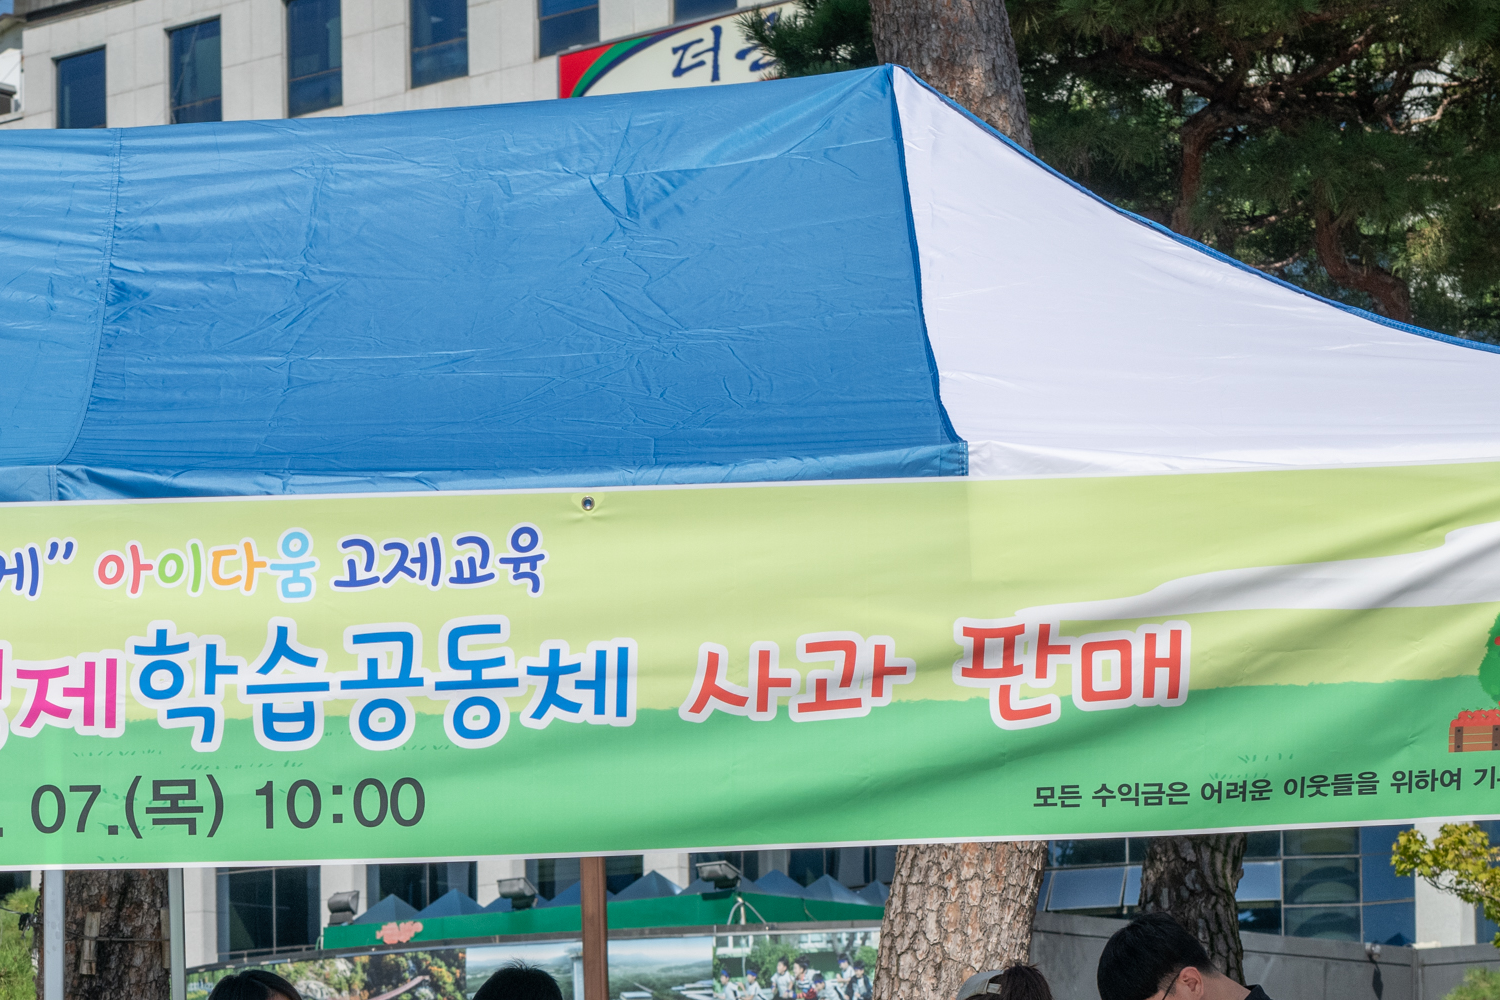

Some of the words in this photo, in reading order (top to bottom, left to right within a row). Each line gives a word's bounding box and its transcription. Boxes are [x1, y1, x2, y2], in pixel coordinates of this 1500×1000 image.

[672, 25, 722, 82] 더
[97, 531, 317, 599] 아이다움
[333, 525, 546, 593] 고제교육
[689, 639, 908, 717] 사과
[960, 621, 1186, 723] 판매
[30, 775, 226, 839] 07.(목)
[256, 777, 426, 830] 10:00
[1033, 784, 1082, 808] 모든
[1092, 782, 1191, 808] 수익금은
[1200, 778, 1273, 804] 어려운
[1283, 771, 1380, 799] 이웃들을
[1390, 767, 1462, 794] 위하여
[1473, 766, 1500, 789] 기
